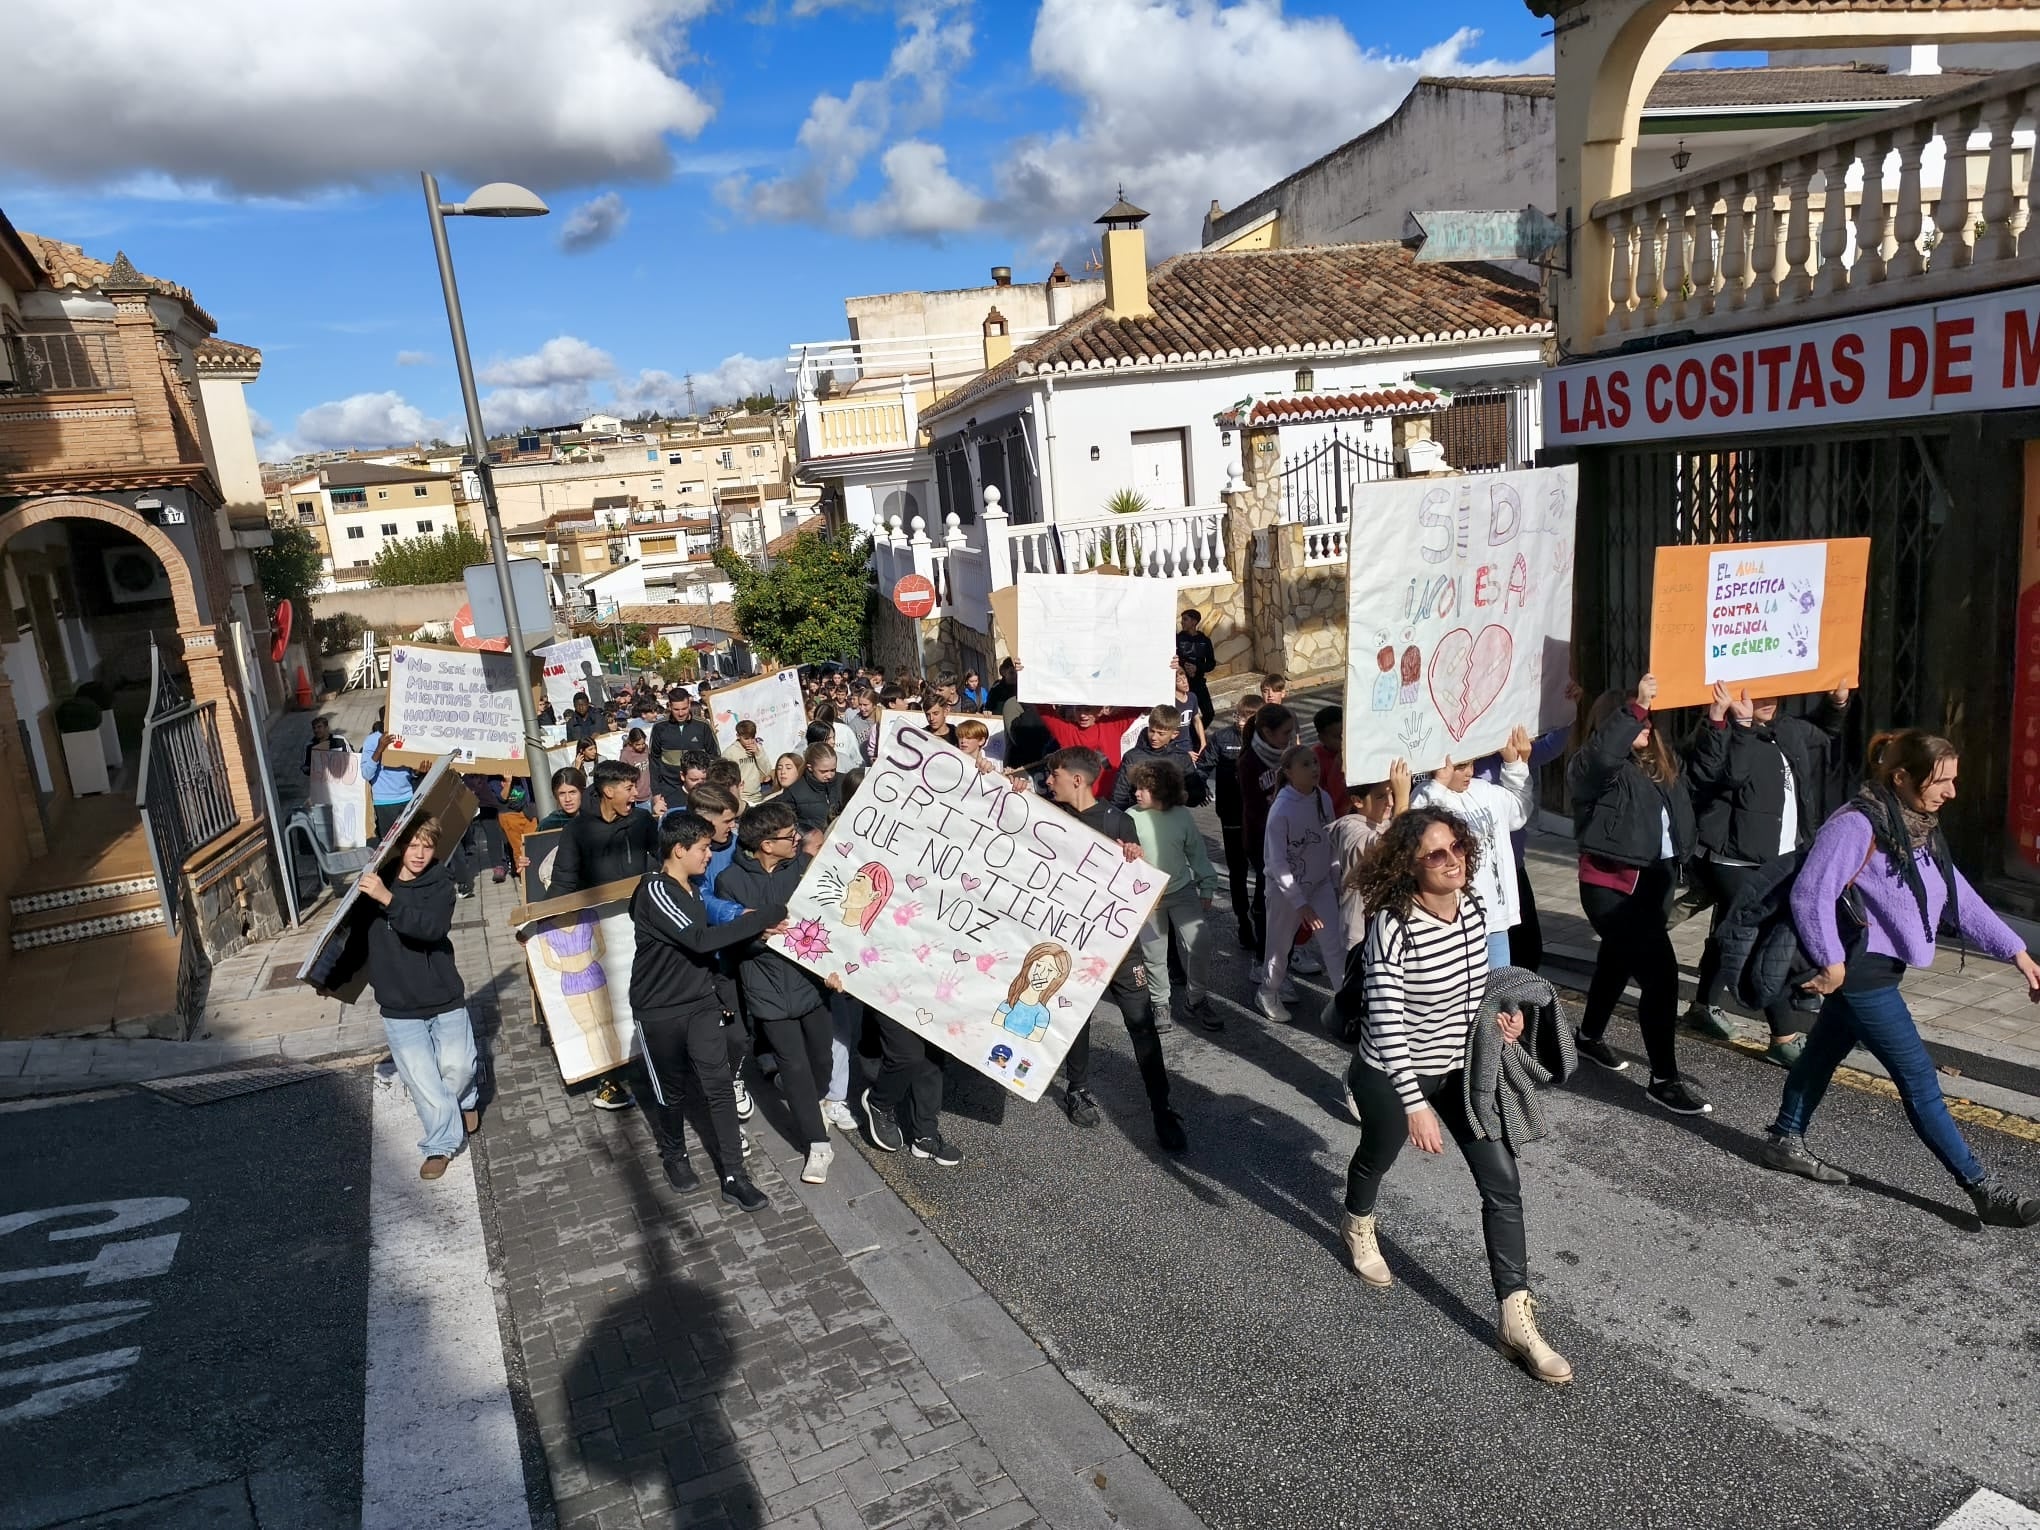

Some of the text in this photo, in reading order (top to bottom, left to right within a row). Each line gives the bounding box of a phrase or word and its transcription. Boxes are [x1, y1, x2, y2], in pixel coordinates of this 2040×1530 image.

[1558, 371, 1631, 434] LAS
[1645, 333, 1865, 423] COSITAS
[1888, 317, 1975, 400] DE
[172, 512, 181, 521] 17
[1717, 560, 1765, 581] EL AULA
[1715, 577, 1786, 600] ESPECÍFICA
[1713, 600, 1778, 618] CONTRA LA
[1712, 620, 1768, 636] VIOLENCIA
[1713, 637, 1780, 657] DE GÉNERO
[887, 726, 1129, 902] SOMOS EL
[873, 771, 1137, 939] GRITO DE LAS
[853, 805, 1095, 951] QUE NO TIENEN
[937, 889, 1001, 943] VOZ
